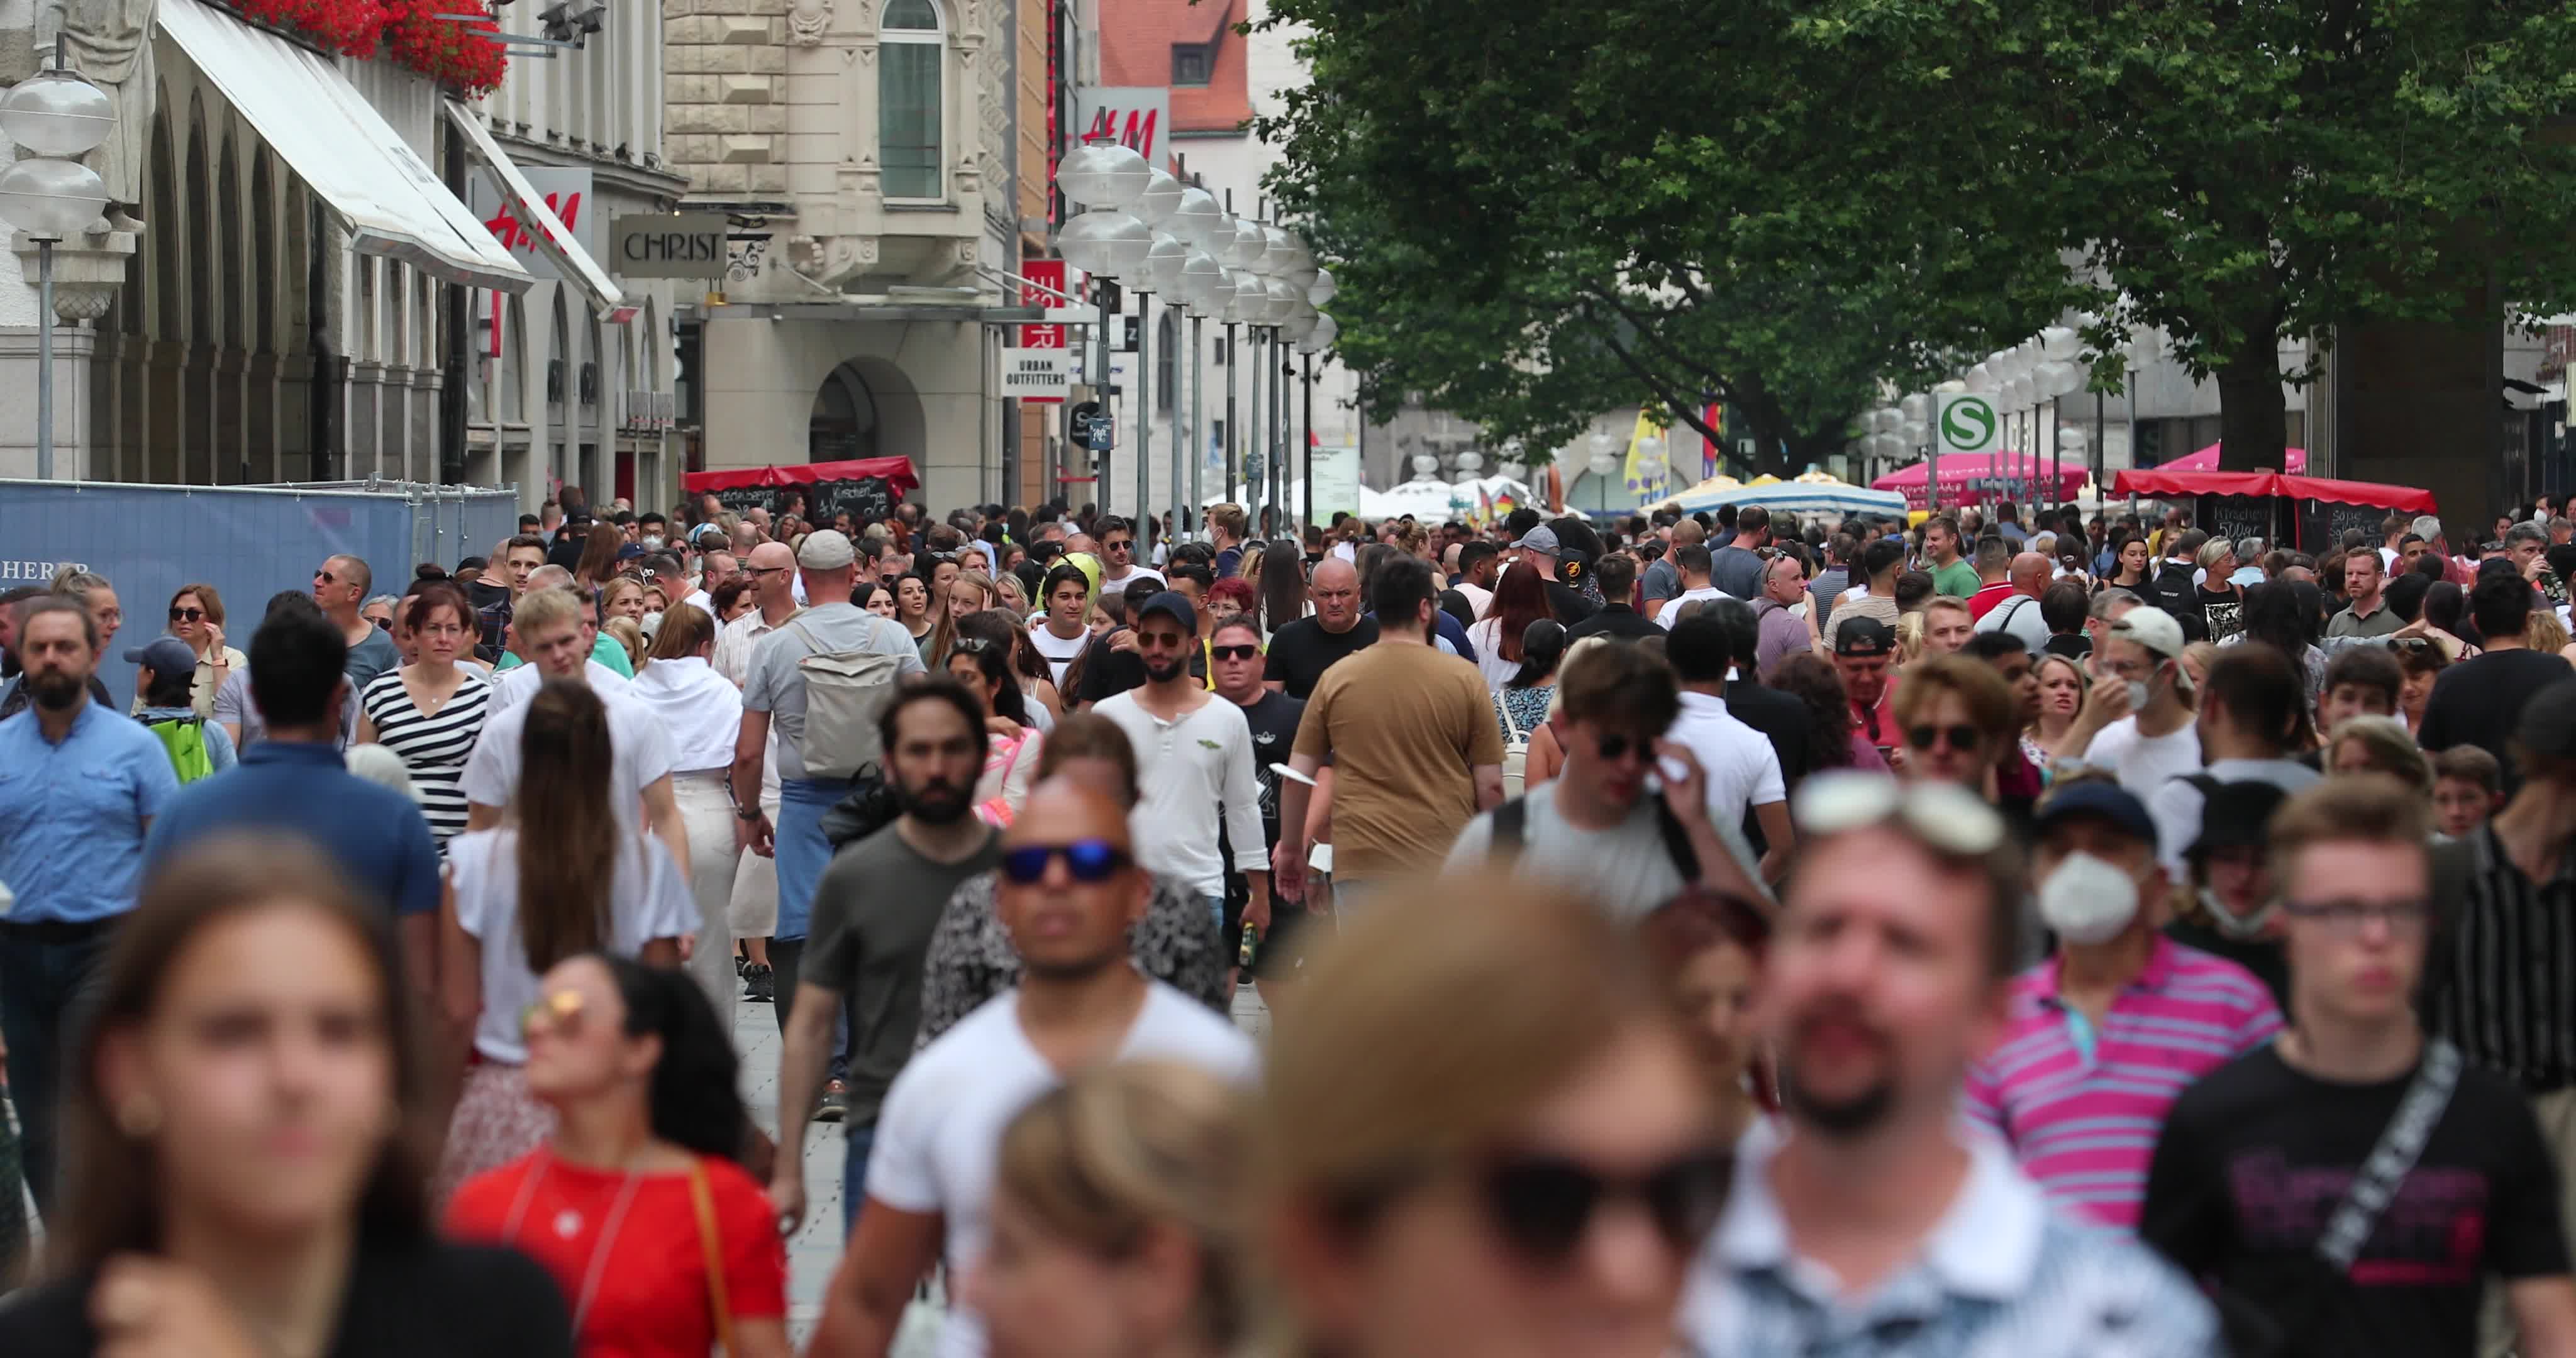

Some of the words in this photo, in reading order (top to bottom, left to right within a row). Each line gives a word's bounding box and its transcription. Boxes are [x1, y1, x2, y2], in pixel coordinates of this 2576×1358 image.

[624, 232, 722, 262] CHRIST
[1019, 360, 1053, 372] URBAN
[1007, 373, 1065, 385] OUTFITTERS
[1950, 400, 1987, 448] S
